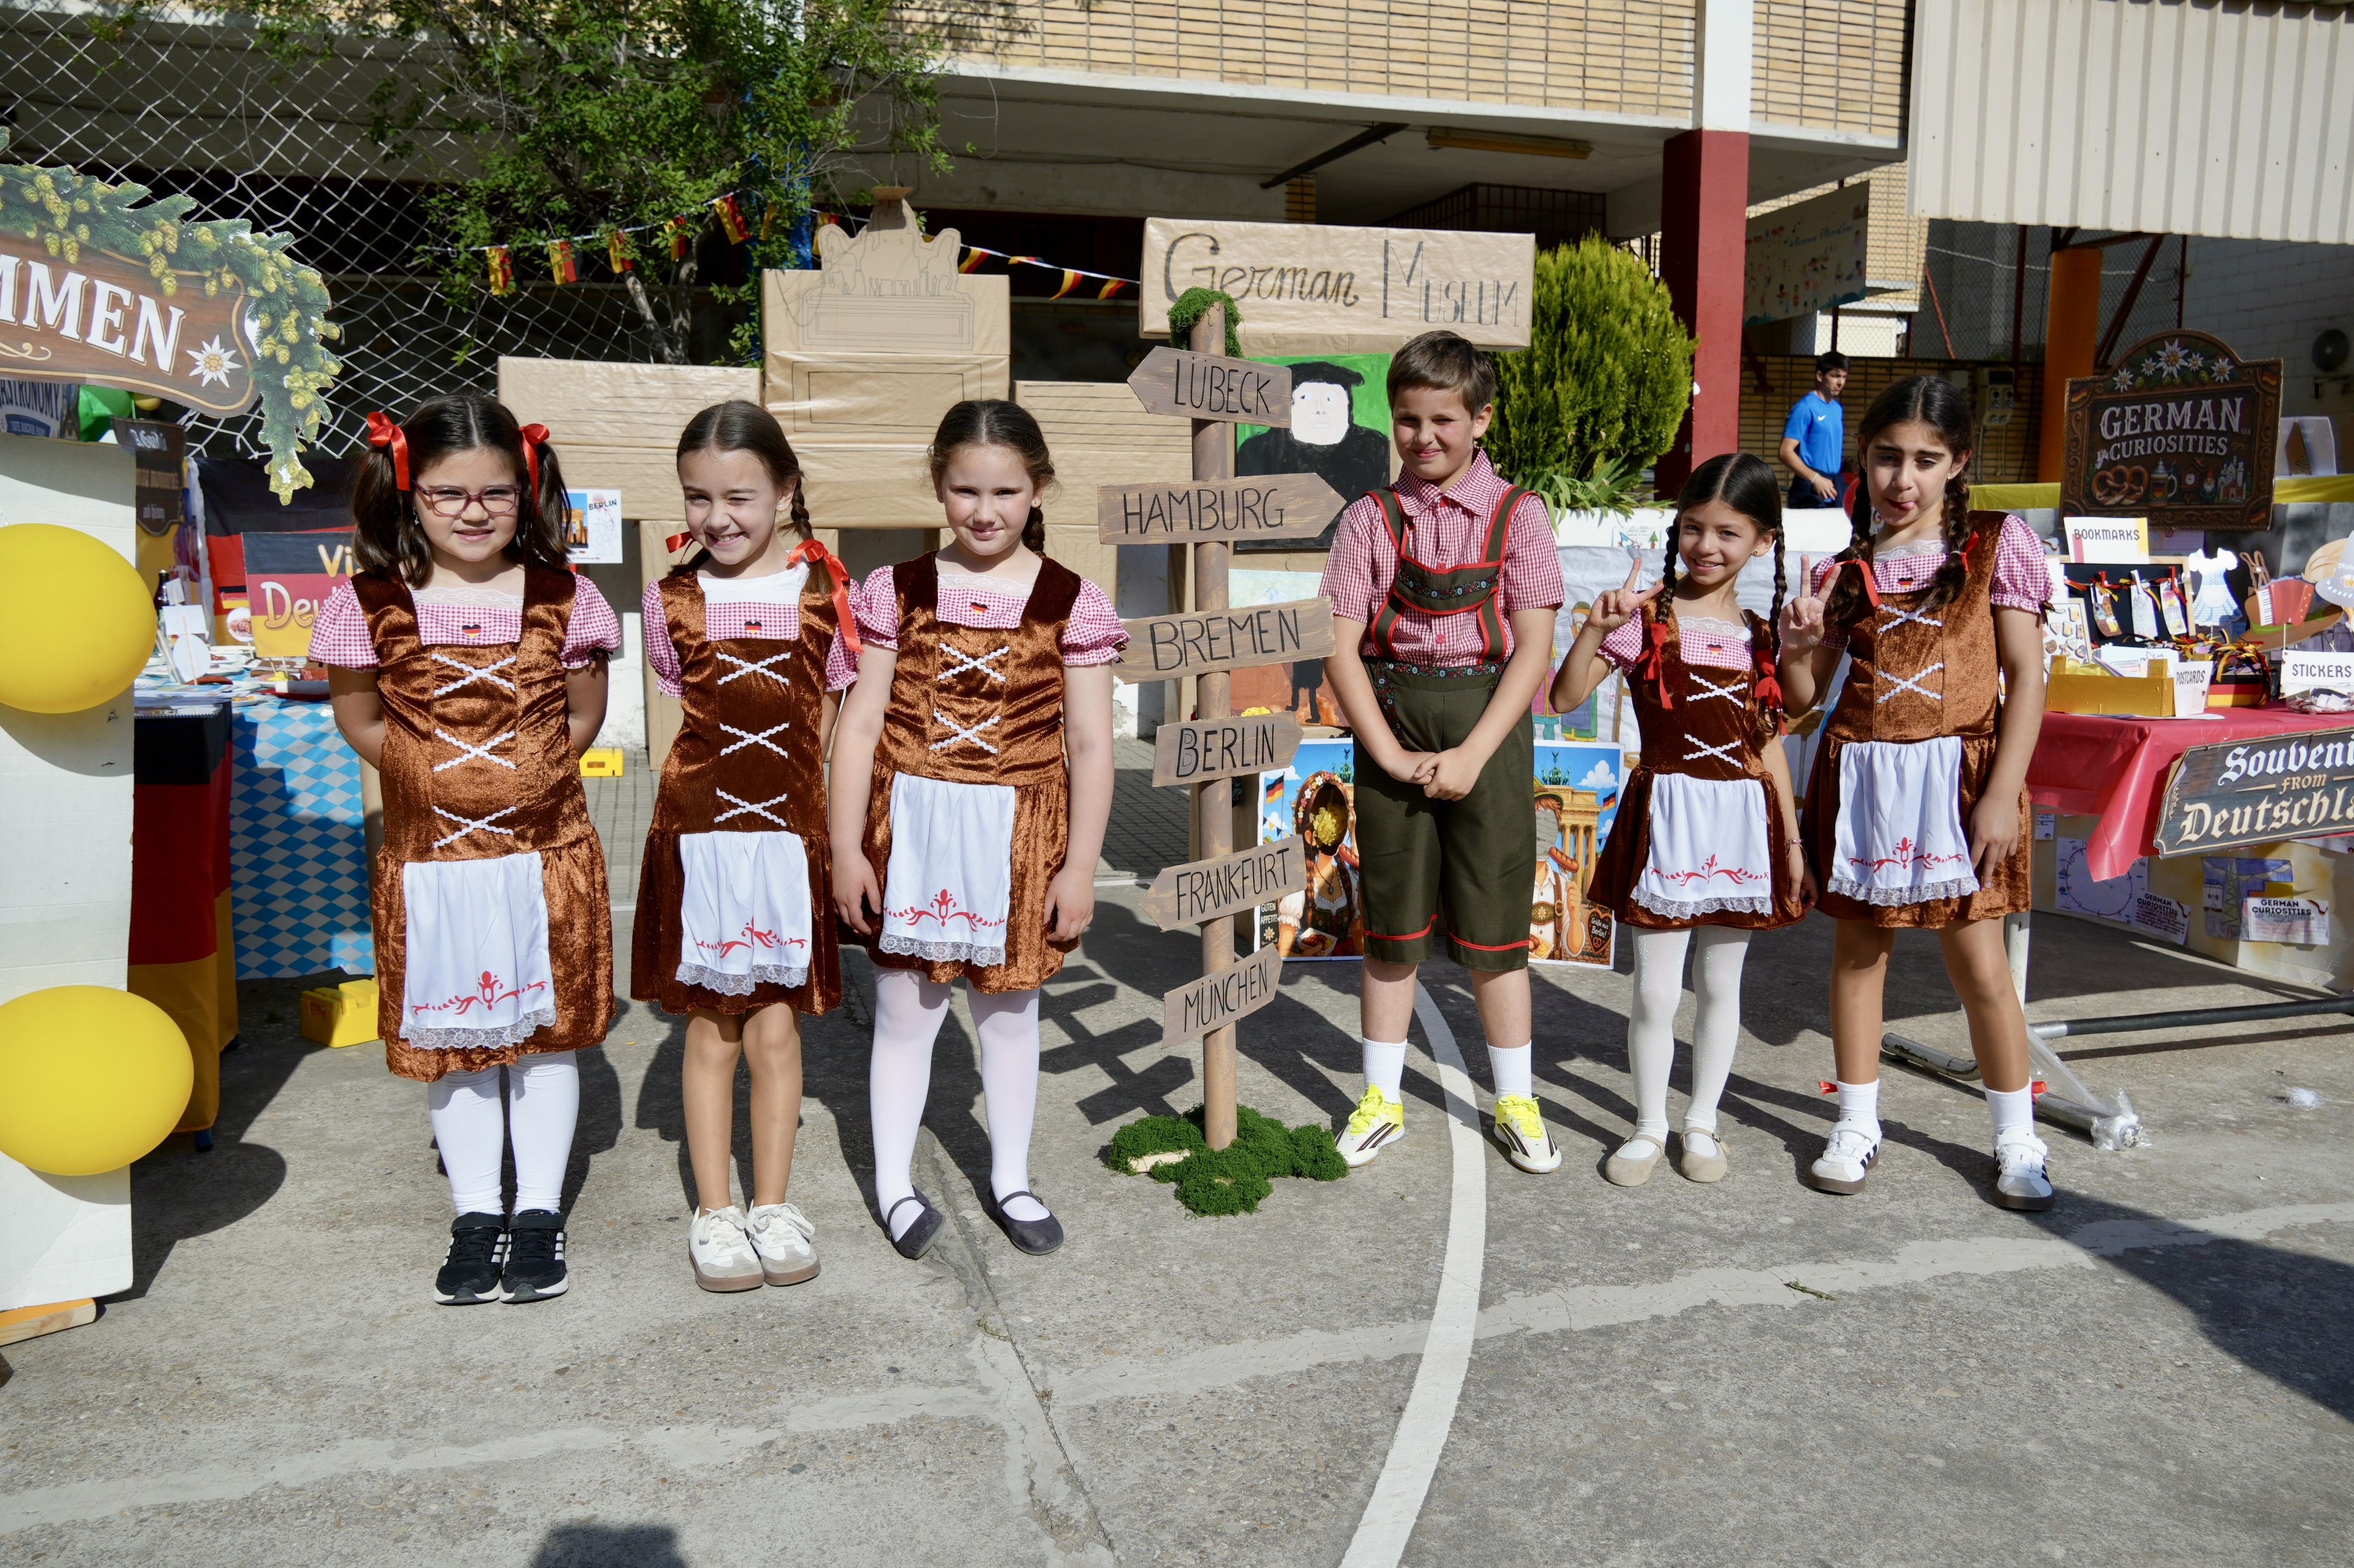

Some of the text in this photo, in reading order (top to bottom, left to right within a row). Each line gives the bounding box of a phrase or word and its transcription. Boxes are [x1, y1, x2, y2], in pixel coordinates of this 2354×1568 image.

[1165, 233, 1358, 307] German
[1174, 357, 1270, 415] LÜBECK
[2099, 397, 2243, 440] GERMAN
[2109, 434, 2228, 461] CURIOSITIES
[588, 499, 617, 510] BERLIN
[1123, 488, 1284, 534] HAMBURG
[2074, 528, 2140, 541] BOOKMARKS
[317, 544, 360, 577] Vi
[1150, 609, 1300, 671] BREMEN
[2176, 670, 2205, 685] POSTCARDS
[2292, 664, 2352, 678] STICKERS
[1176, 723, 1275, 778] BERLIN
[1176, 848, 1289, 920] FRANKFURT
[1261, 903, 1276, 912] GUTEN
[2137, 898, 2178, 916] CURIOSITIES
[2145, 894, 2171, 906] GERMAN
[1260, 913, 1277, 925] APPETIT!
[2252, 906, 2312, 916] CURIOSITIES
[1591, 917, 1602, 927] Grüße
[1592, 926, 1607, 938] Berlin!
[1185, 959, 1268, 1033] MÜNCHEN
